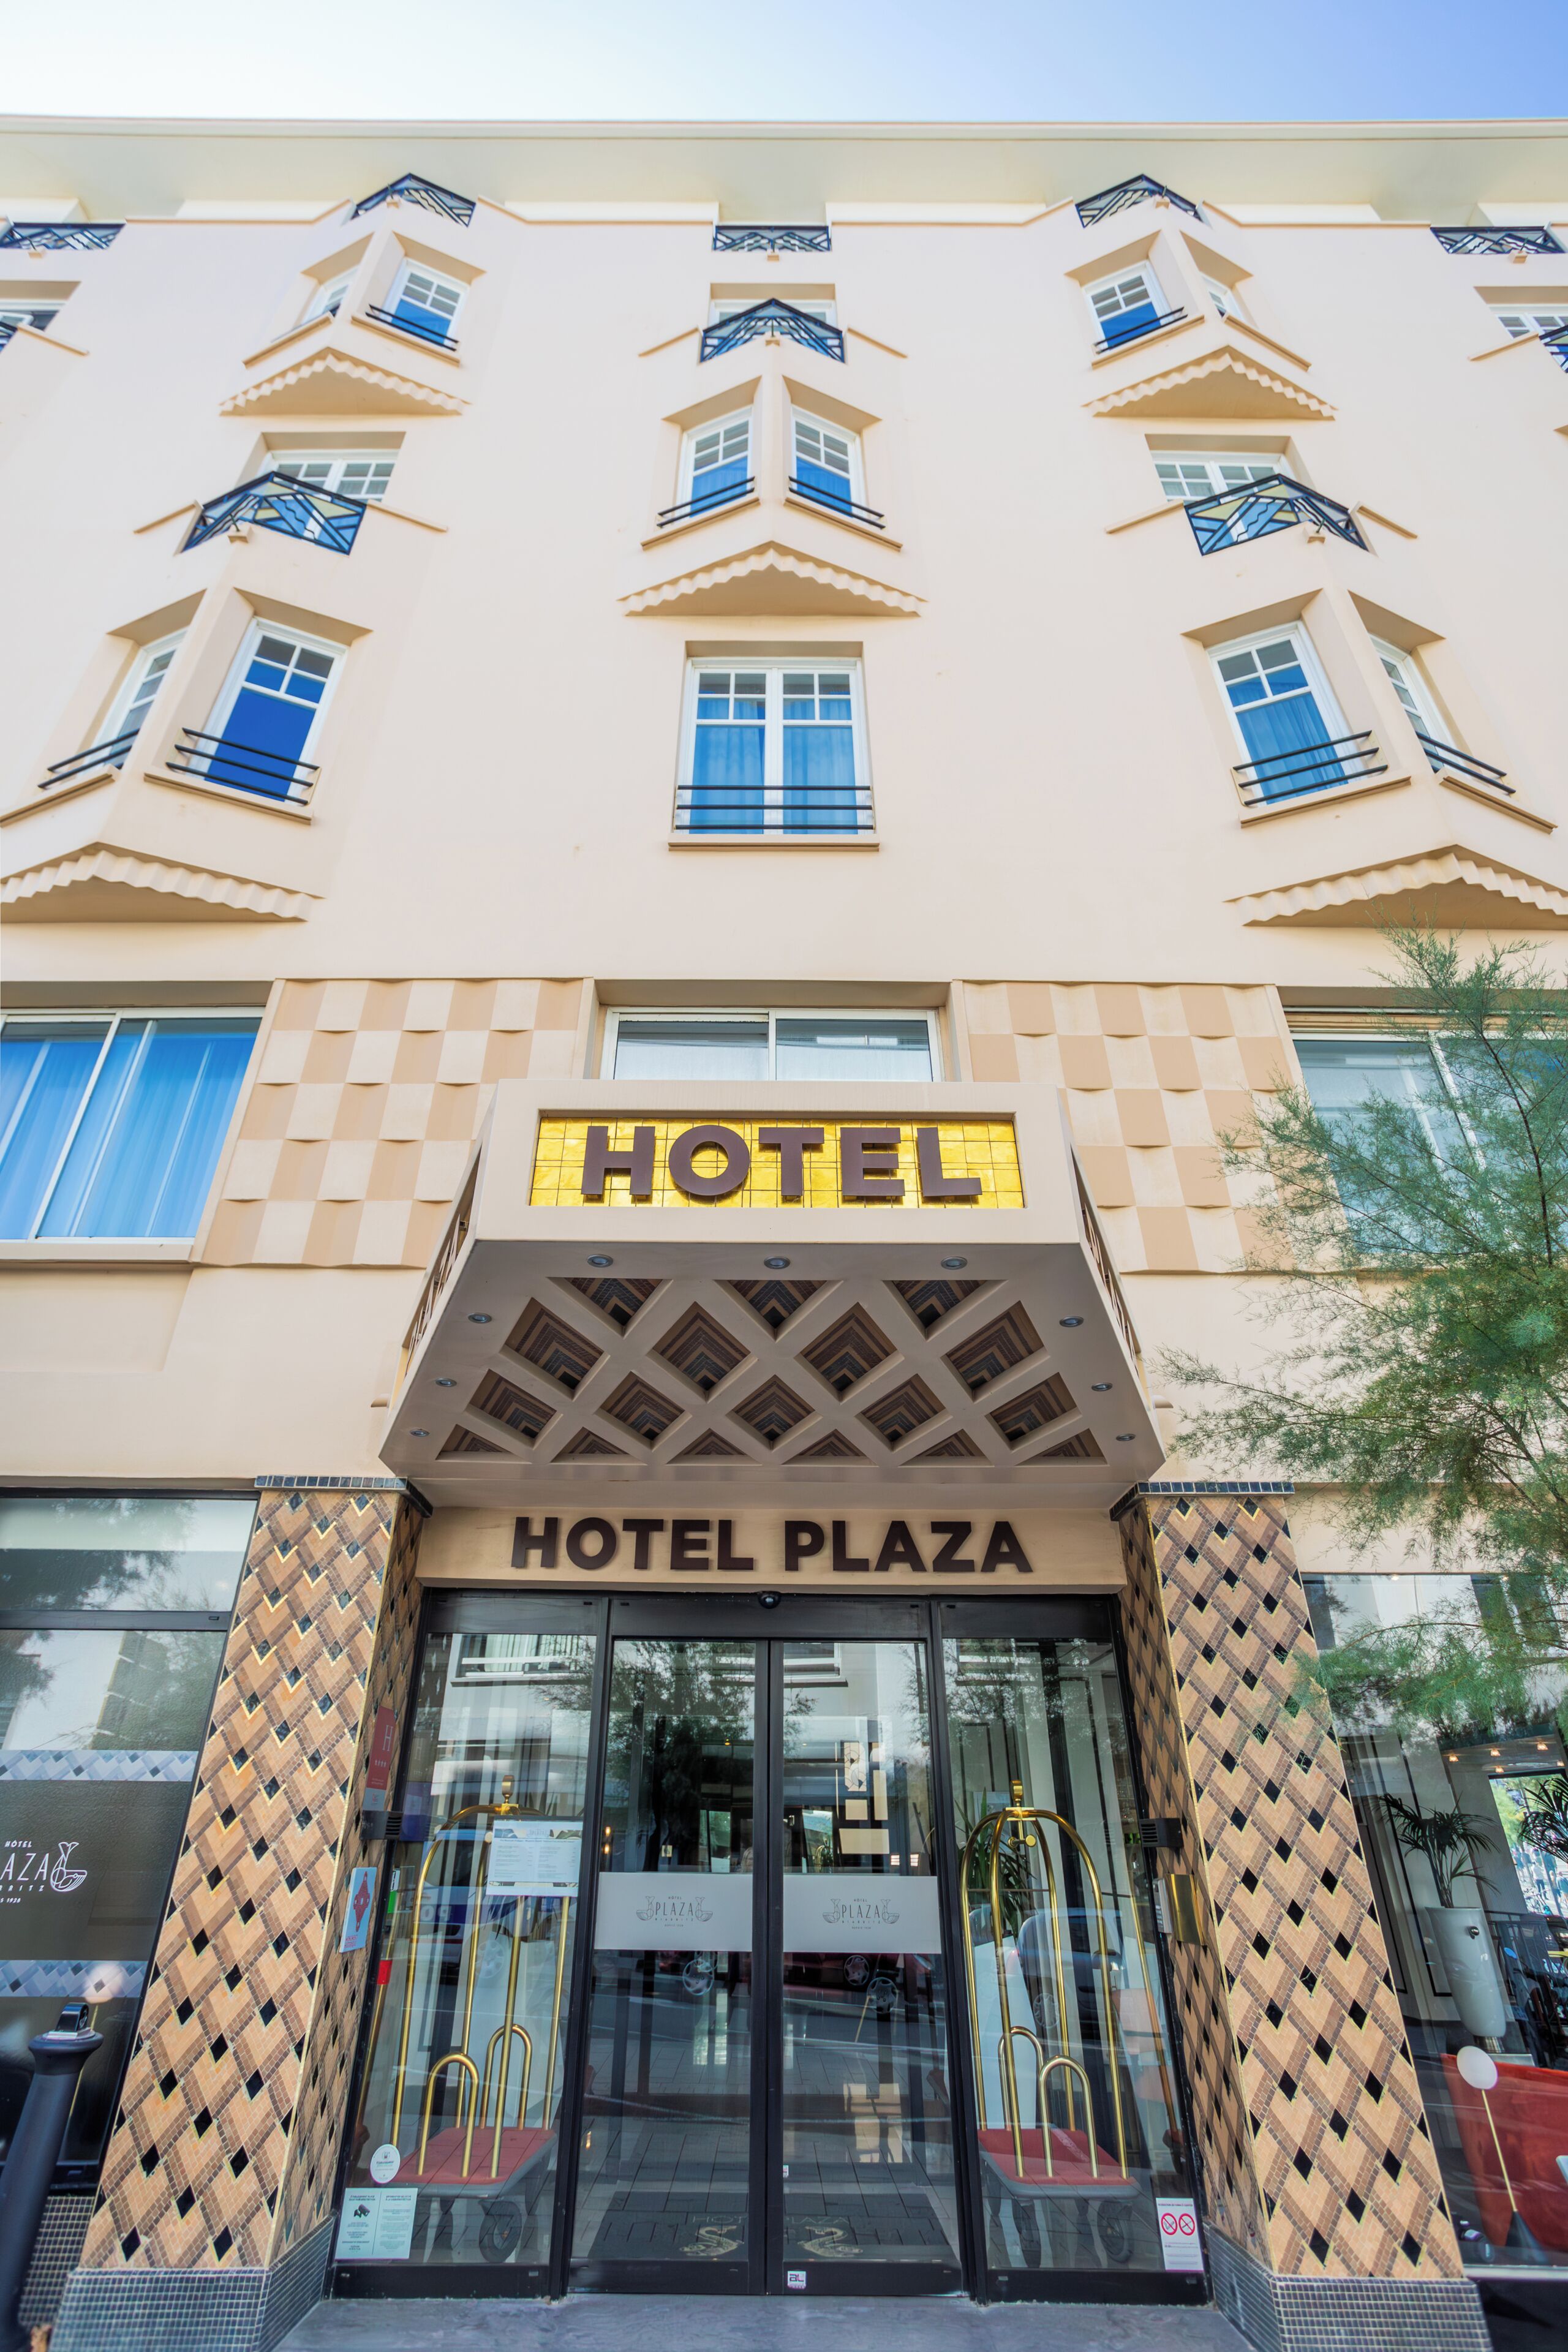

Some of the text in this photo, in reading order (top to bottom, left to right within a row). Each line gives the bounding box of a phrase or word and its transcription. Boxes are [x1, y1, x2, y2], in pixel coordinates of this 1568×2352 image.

[581, 1125, 982, 1196] HOTEL
[510, 1517, 1034, 1573] HOTEL PLAZA
[655, 1902, 693, 1916] PLAZA
[842, 1904, 880, 1918] PLAZA
